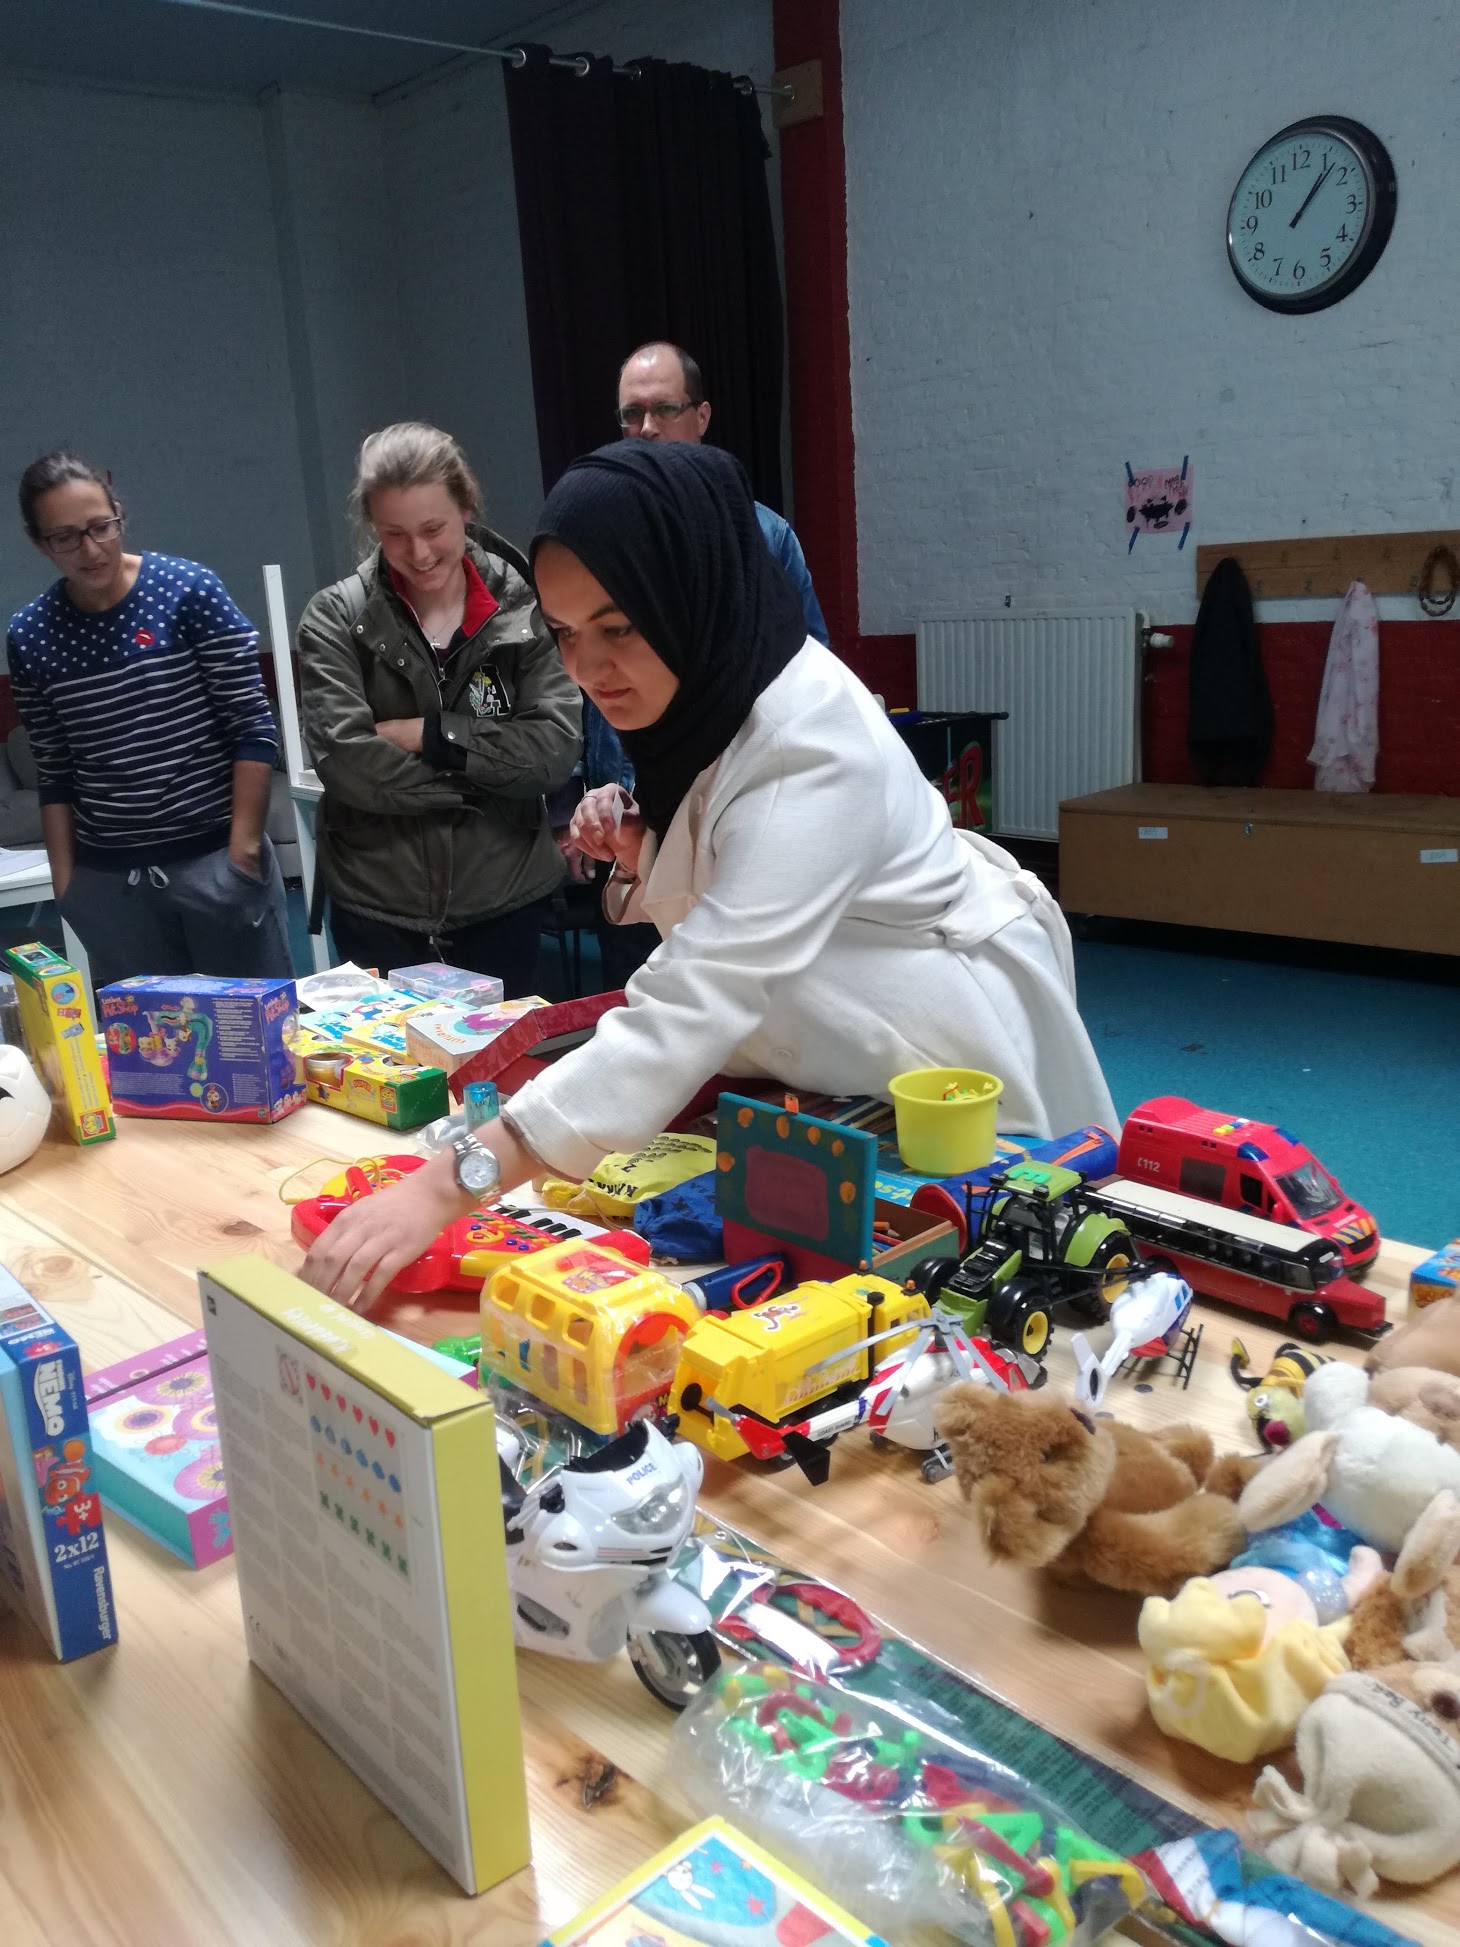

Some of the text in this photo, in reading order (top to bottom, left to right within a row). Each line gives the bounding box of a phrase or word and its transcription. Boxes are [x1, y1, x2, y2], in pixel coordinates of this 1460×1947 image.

[1292, 150, 1310, 170] 12
[1321, 152, 1327, 171] 1
[1271, 164, 1286, 185] 11
[1336, 167, 1347, 185] 2
[1254, 189, 1272, 210] 10
[1346, 194, 1357, 214] 3
[1246, 215, 1258, 235] 9
[1335, 223, 1348, 242] 4
[1253, 242, 1265, 261] 8
[1320, 247, 1331, 267] 5
[1273, 258, 1283, 276] 7
[1293, 260, 1305, 279] 6
[39, 1361, 65, 1437] NEMO
[627, 1463, 657, 1485] POLICE
[74, 1500, 92, 1520] 3+
[54, 1532, 99, 1563] 2x12
[94, 1565, 111, 1640] Ravensburger
